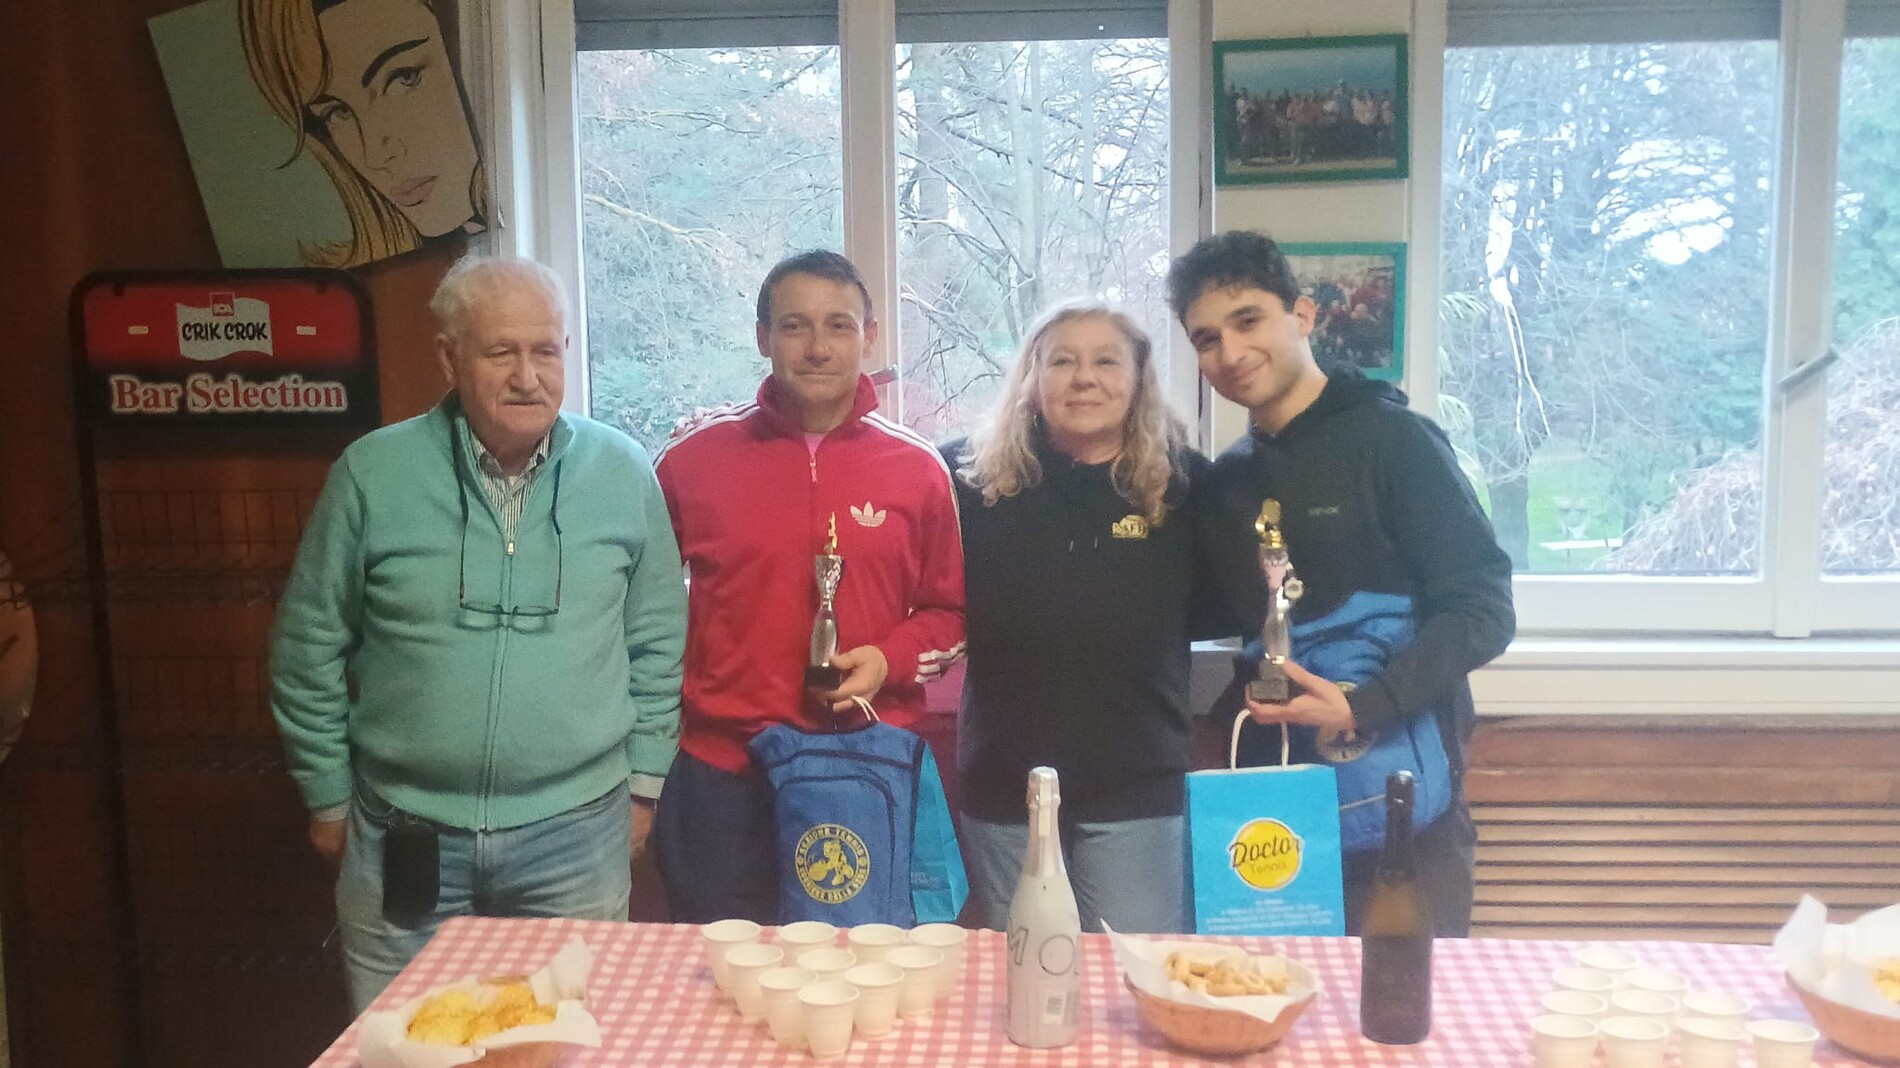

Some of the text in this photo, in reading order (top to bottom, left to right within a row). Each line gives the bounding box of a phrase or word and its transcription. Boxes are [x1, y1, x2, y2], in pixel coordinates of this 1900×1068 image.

[181, 320, 269, 341] CRIK CROK
[112, 375, 346, 412] Bar Selection
[1229, 834, 1301, 868] Doctor
[1250, 860, 1287, 875] Tennis
